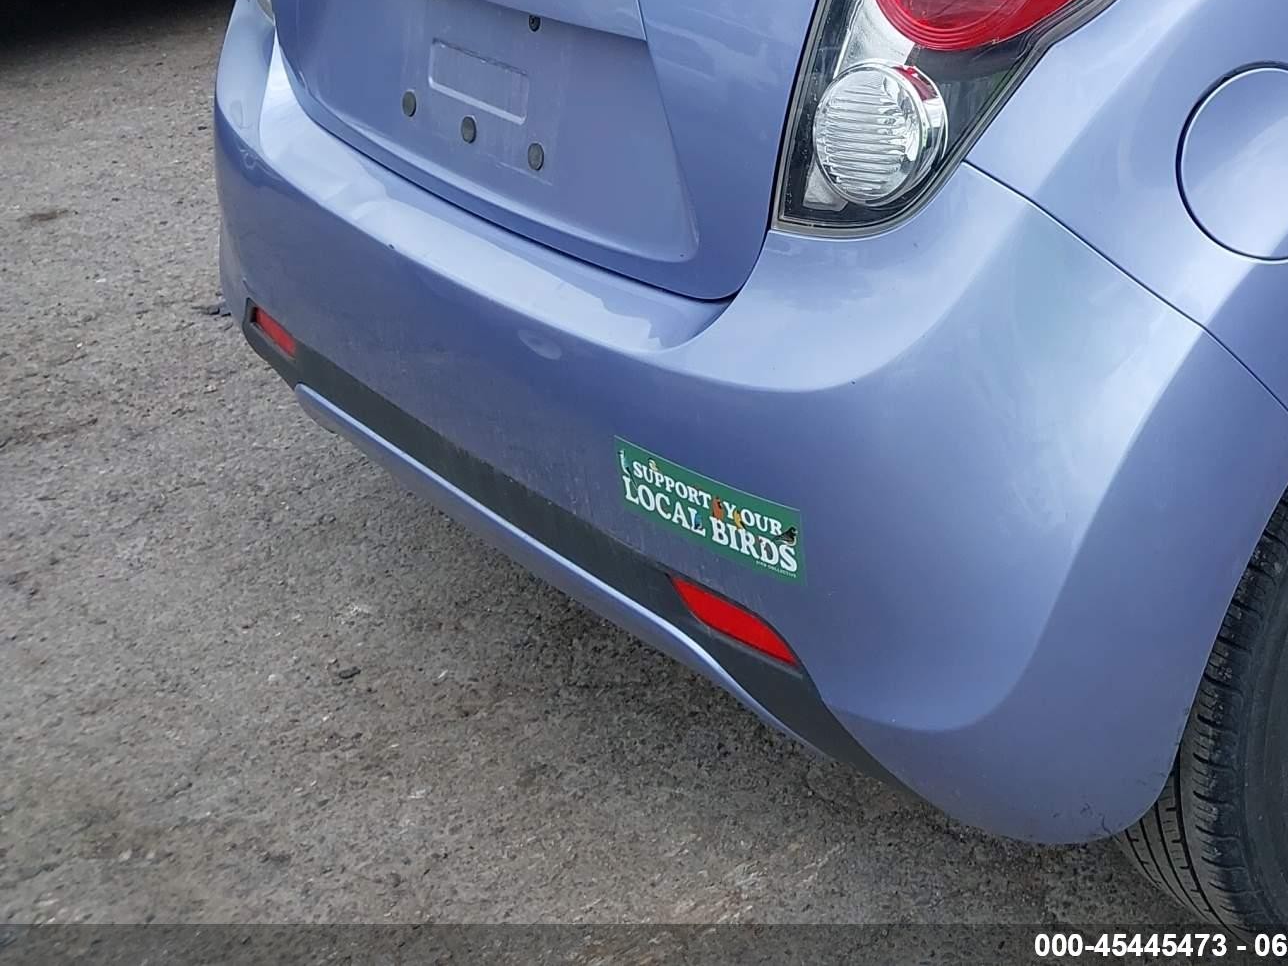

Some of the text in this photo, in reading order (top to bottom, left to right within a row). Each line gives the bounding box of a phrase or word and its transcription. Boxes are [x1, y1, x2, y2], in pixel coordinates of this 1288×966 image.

[622, 474, 798, 572] LOCAL BIRDS
[632, 460, 783, 537] SUPPORT YOUR
